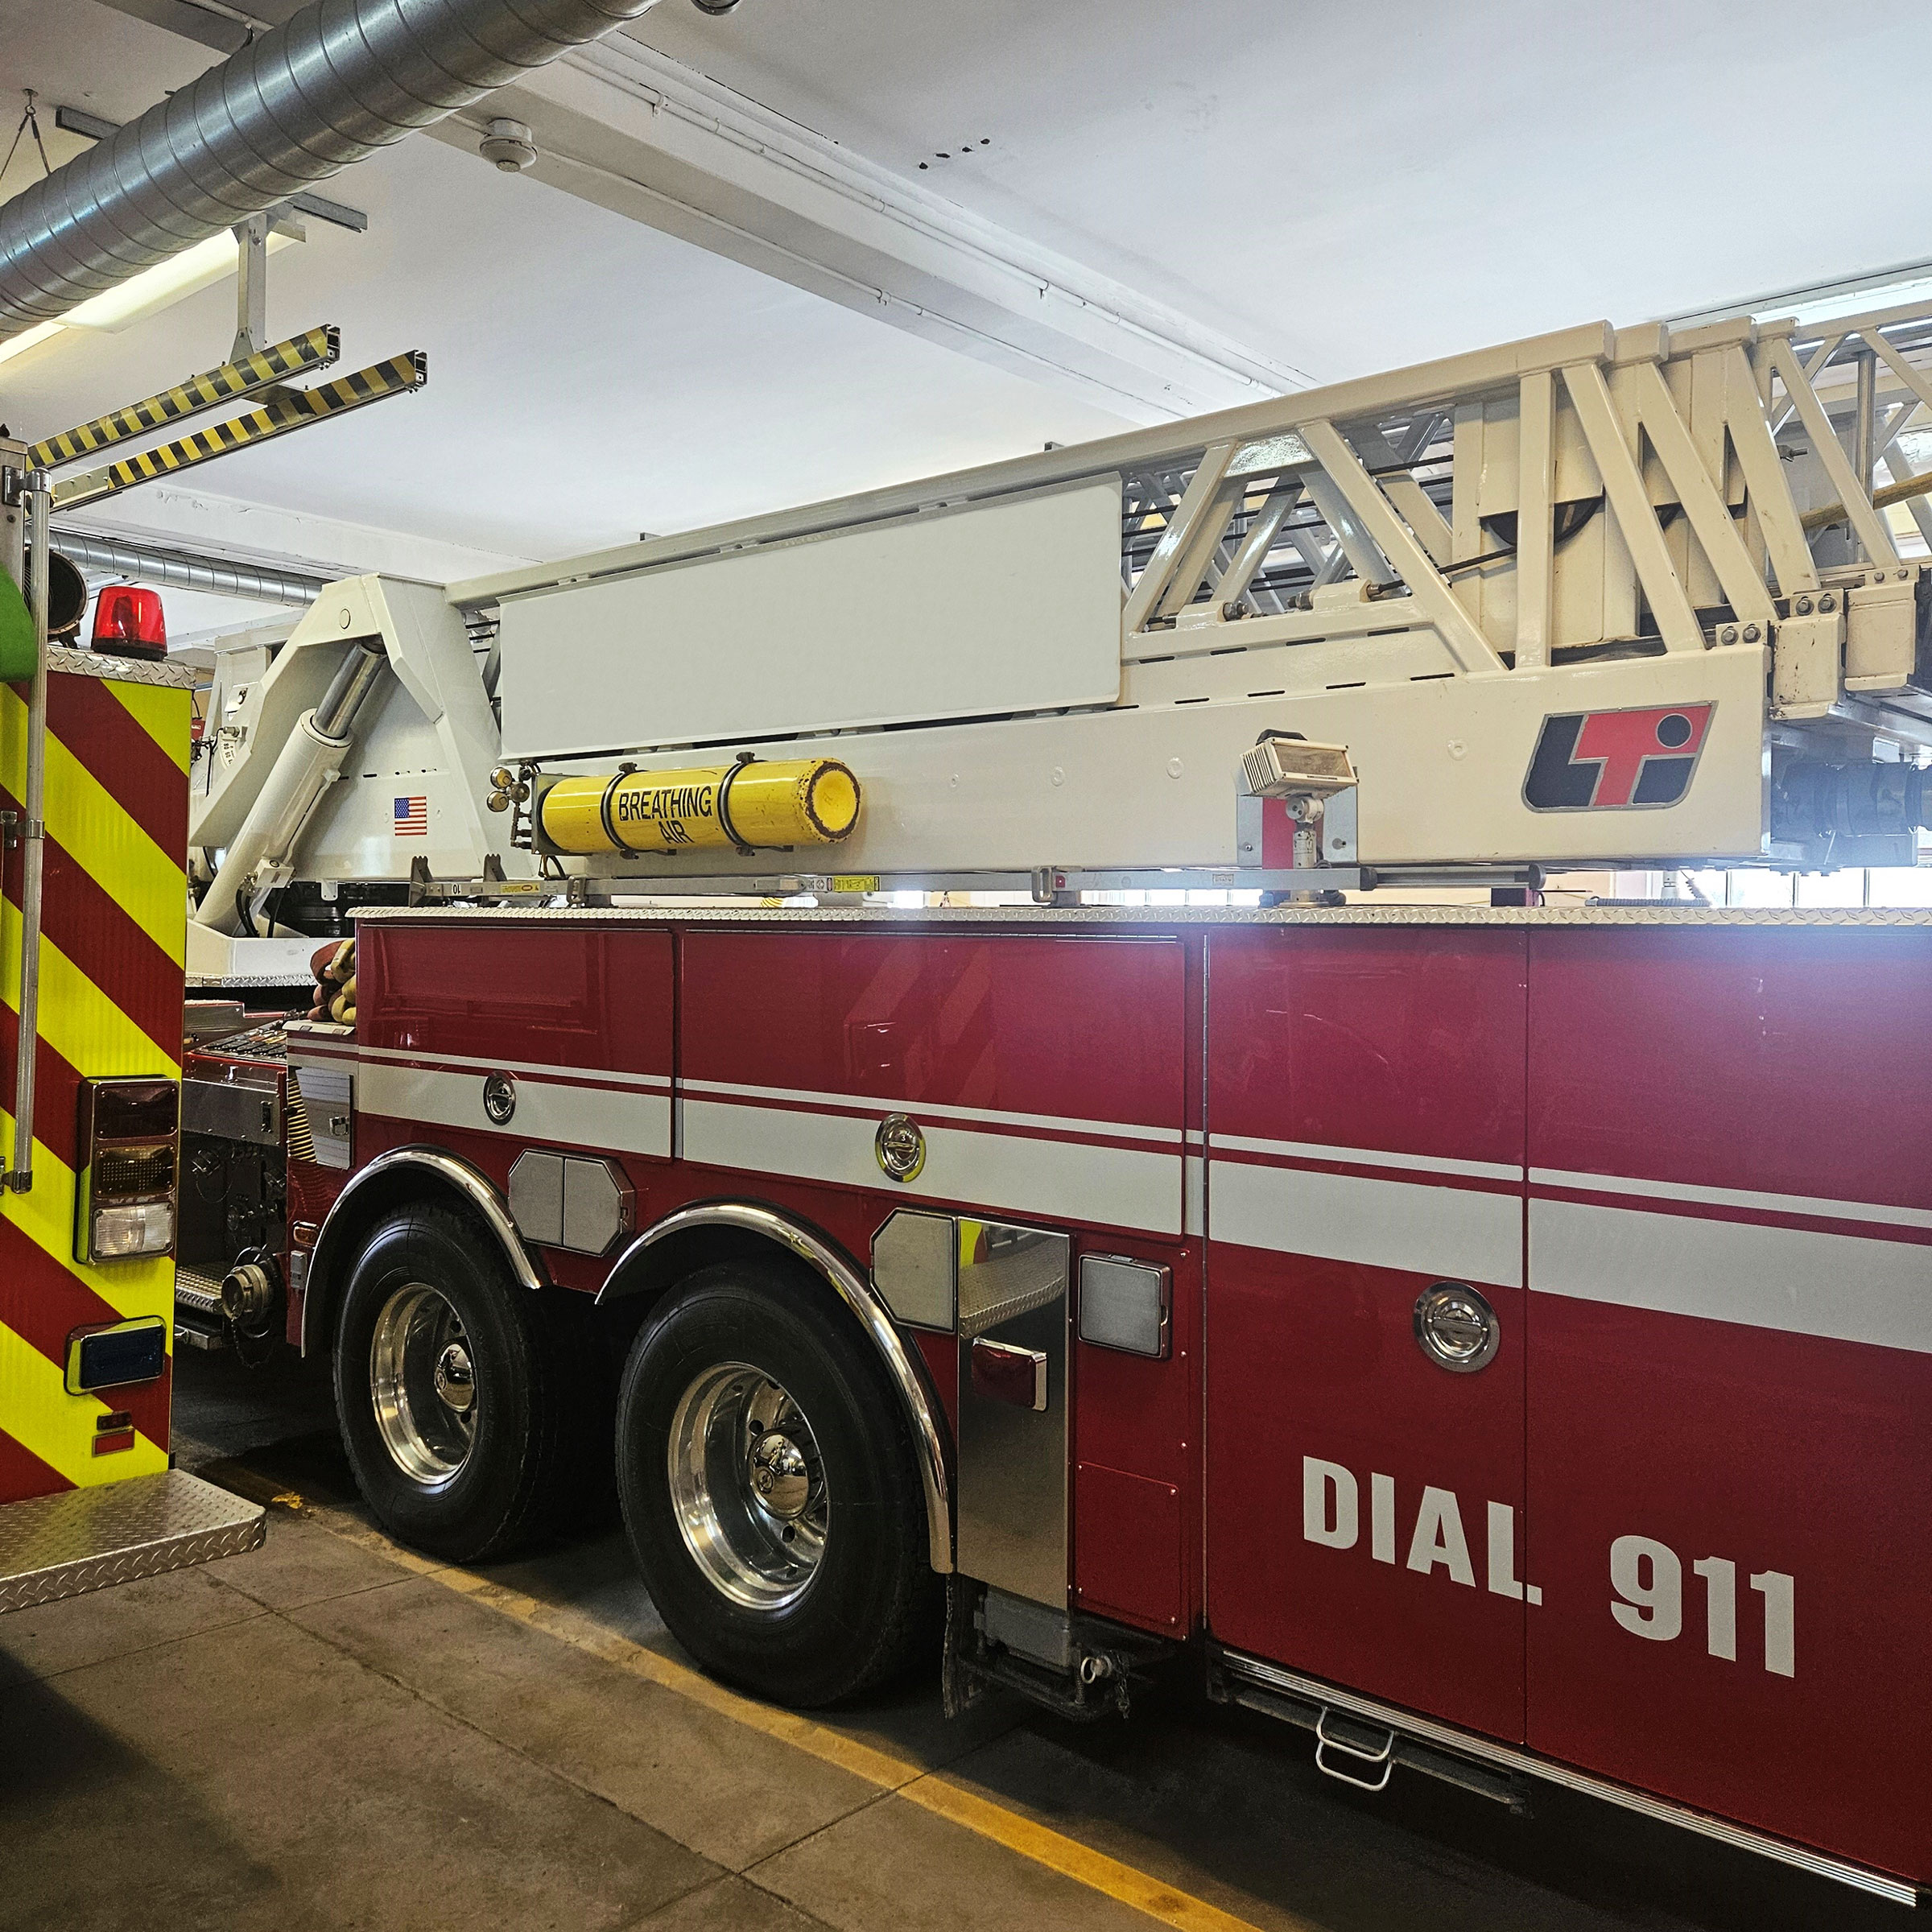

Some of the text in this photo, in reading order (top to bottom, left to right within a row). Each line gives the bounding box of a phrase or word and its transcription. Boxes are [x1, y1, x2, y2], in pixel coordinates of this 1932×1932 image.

[619, 786, 712, 821] BREATHING
[658, 819, 695, 844] AIR
[1302, 1455, 1794, 1678] DIAL 911
